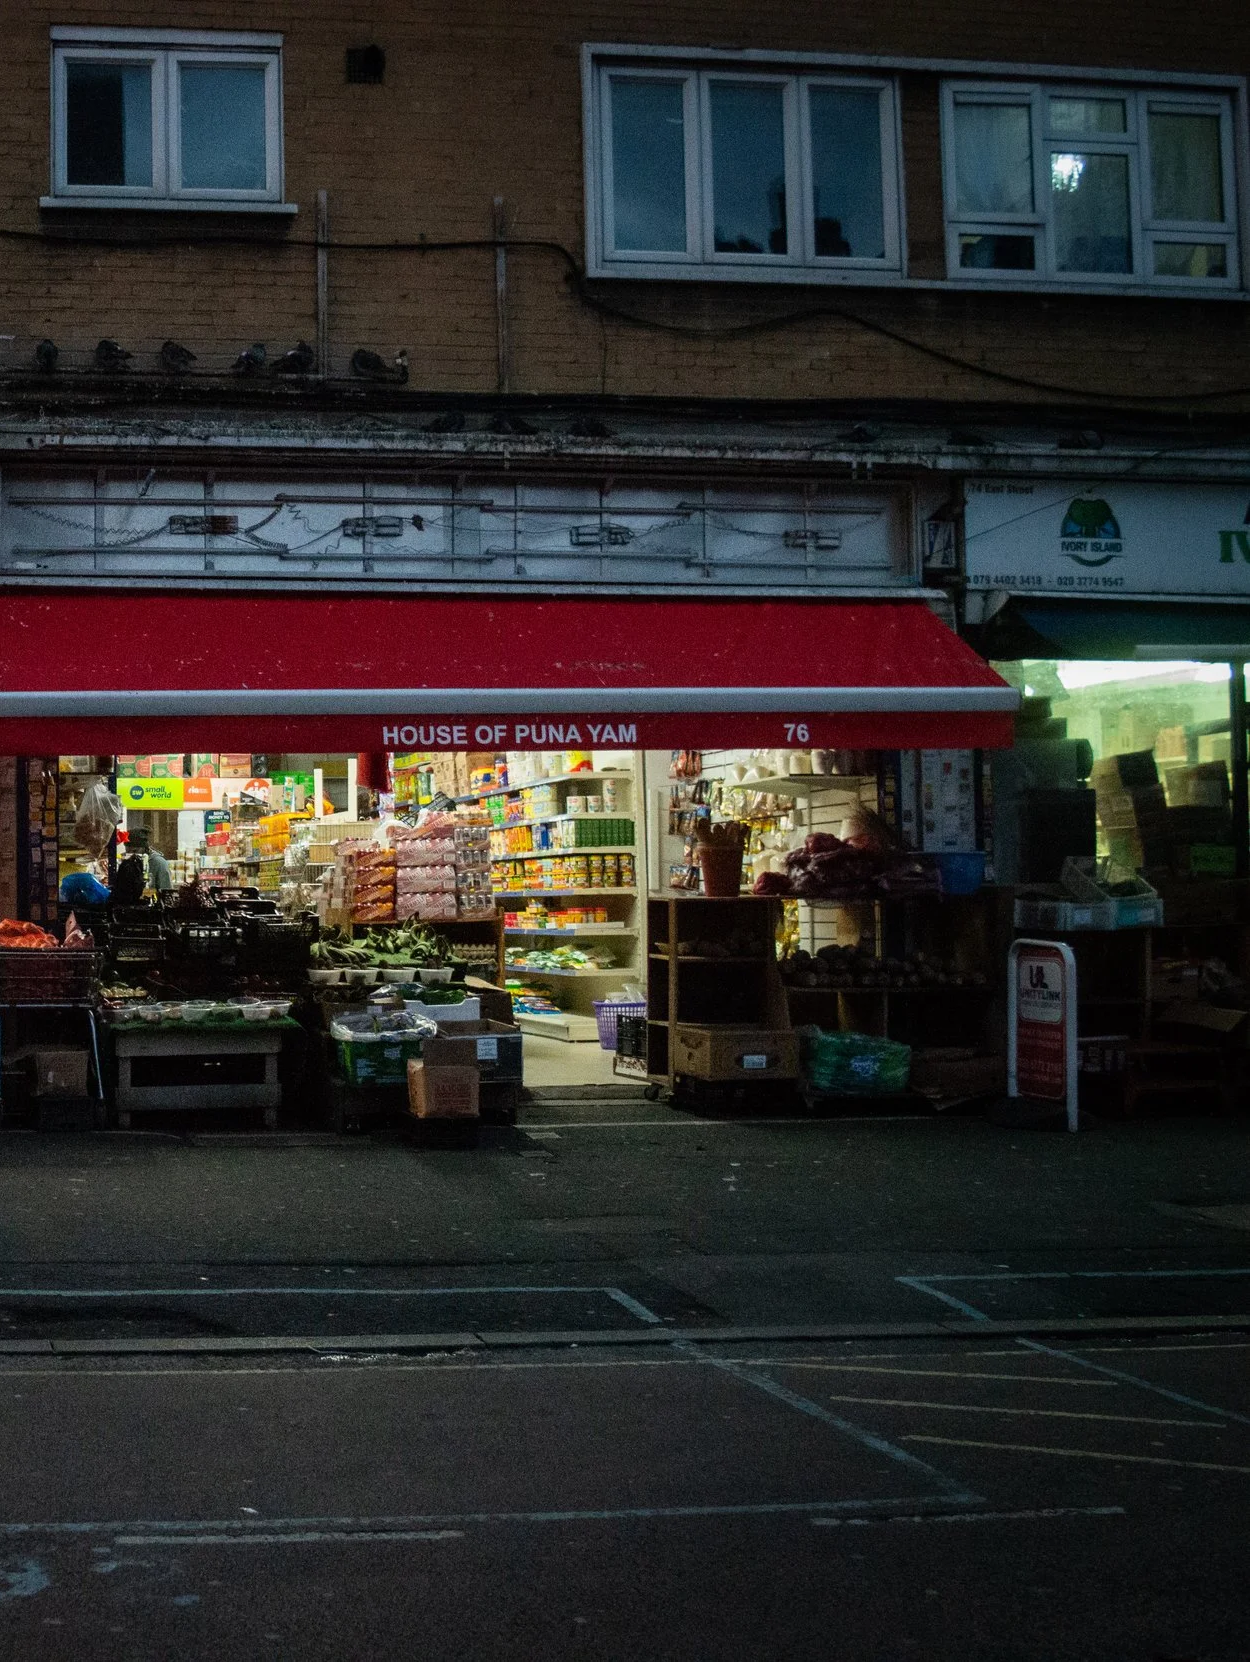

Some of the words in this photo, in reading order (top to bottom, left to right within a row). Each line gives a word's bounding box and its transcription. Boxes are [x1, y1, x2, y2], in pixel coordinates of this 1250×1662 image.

[1061, 541, 1088, 552] IVORY
[1091, 542, 1122, 553] ISLAND
[381, 725, 469, 746] HOUSE
[473, 725, 508, 745] OF
[514, 724, 582, 744] PUNA
[586, 723, 638, 743] YAM
[783, 723, 810, 743] 76
[145, 786, 166, 794] small
[150, 792, 172, 800] world
